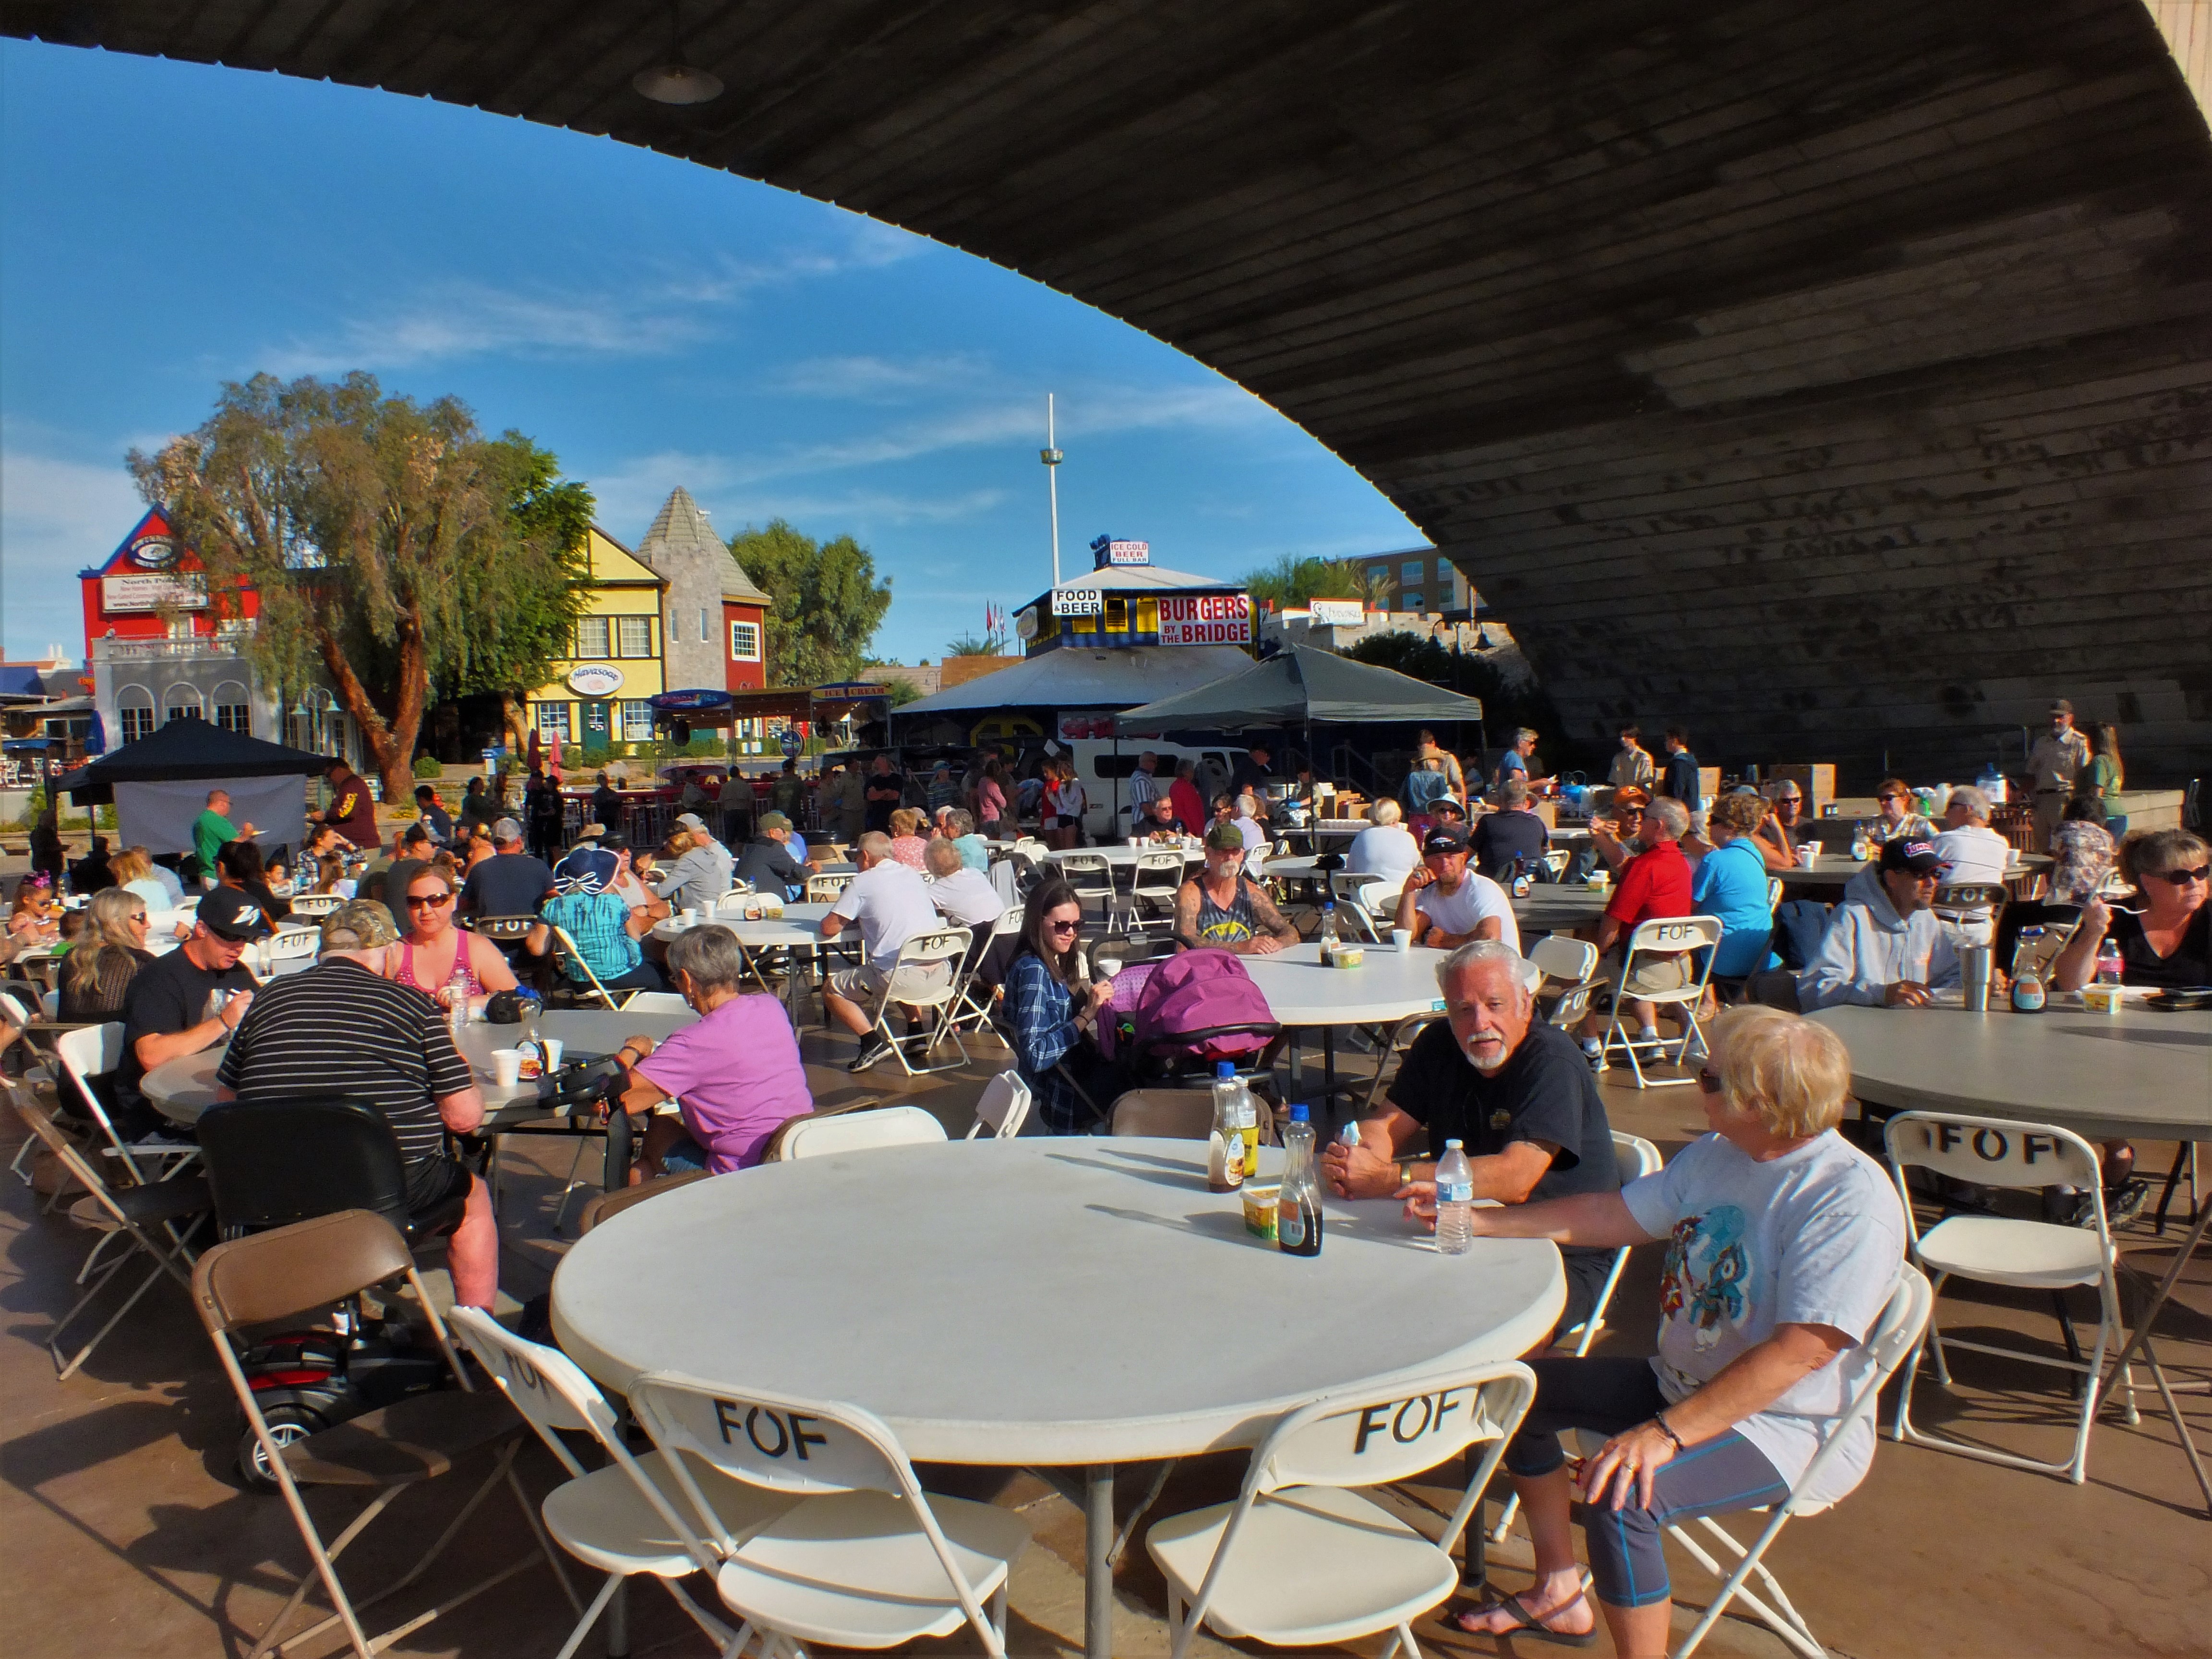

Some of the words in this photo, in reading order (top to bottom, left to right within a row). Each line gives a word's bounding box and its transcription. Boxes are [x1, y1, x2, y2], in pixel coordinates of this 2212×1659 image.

[1057, 591, 1097, 601] FOOD
[1061, 602, 1100, 613] BEER
[1160, 598, 1249, 621] BURGERS
[1161, 635, 1179, 643] THE
[1181, 623, 1249, 642] BRIDGE
[1164, 625, 1176, 634] BY
[1072, 856, 1098, 865] FOF
[1152, 856, 1171, 865] FOF
[1947, 888, 1989, 902] FOF
[1657, 924, 1694, 940] FOF
[280, 934, 309, 949] FOF
[922, 936, 950, 952] FOF
[1938, 1123, 2052, 1165] FOF
[713, 1398, 827, 1460] FOF
[1353, 1389, 1460, 1455] FOF
